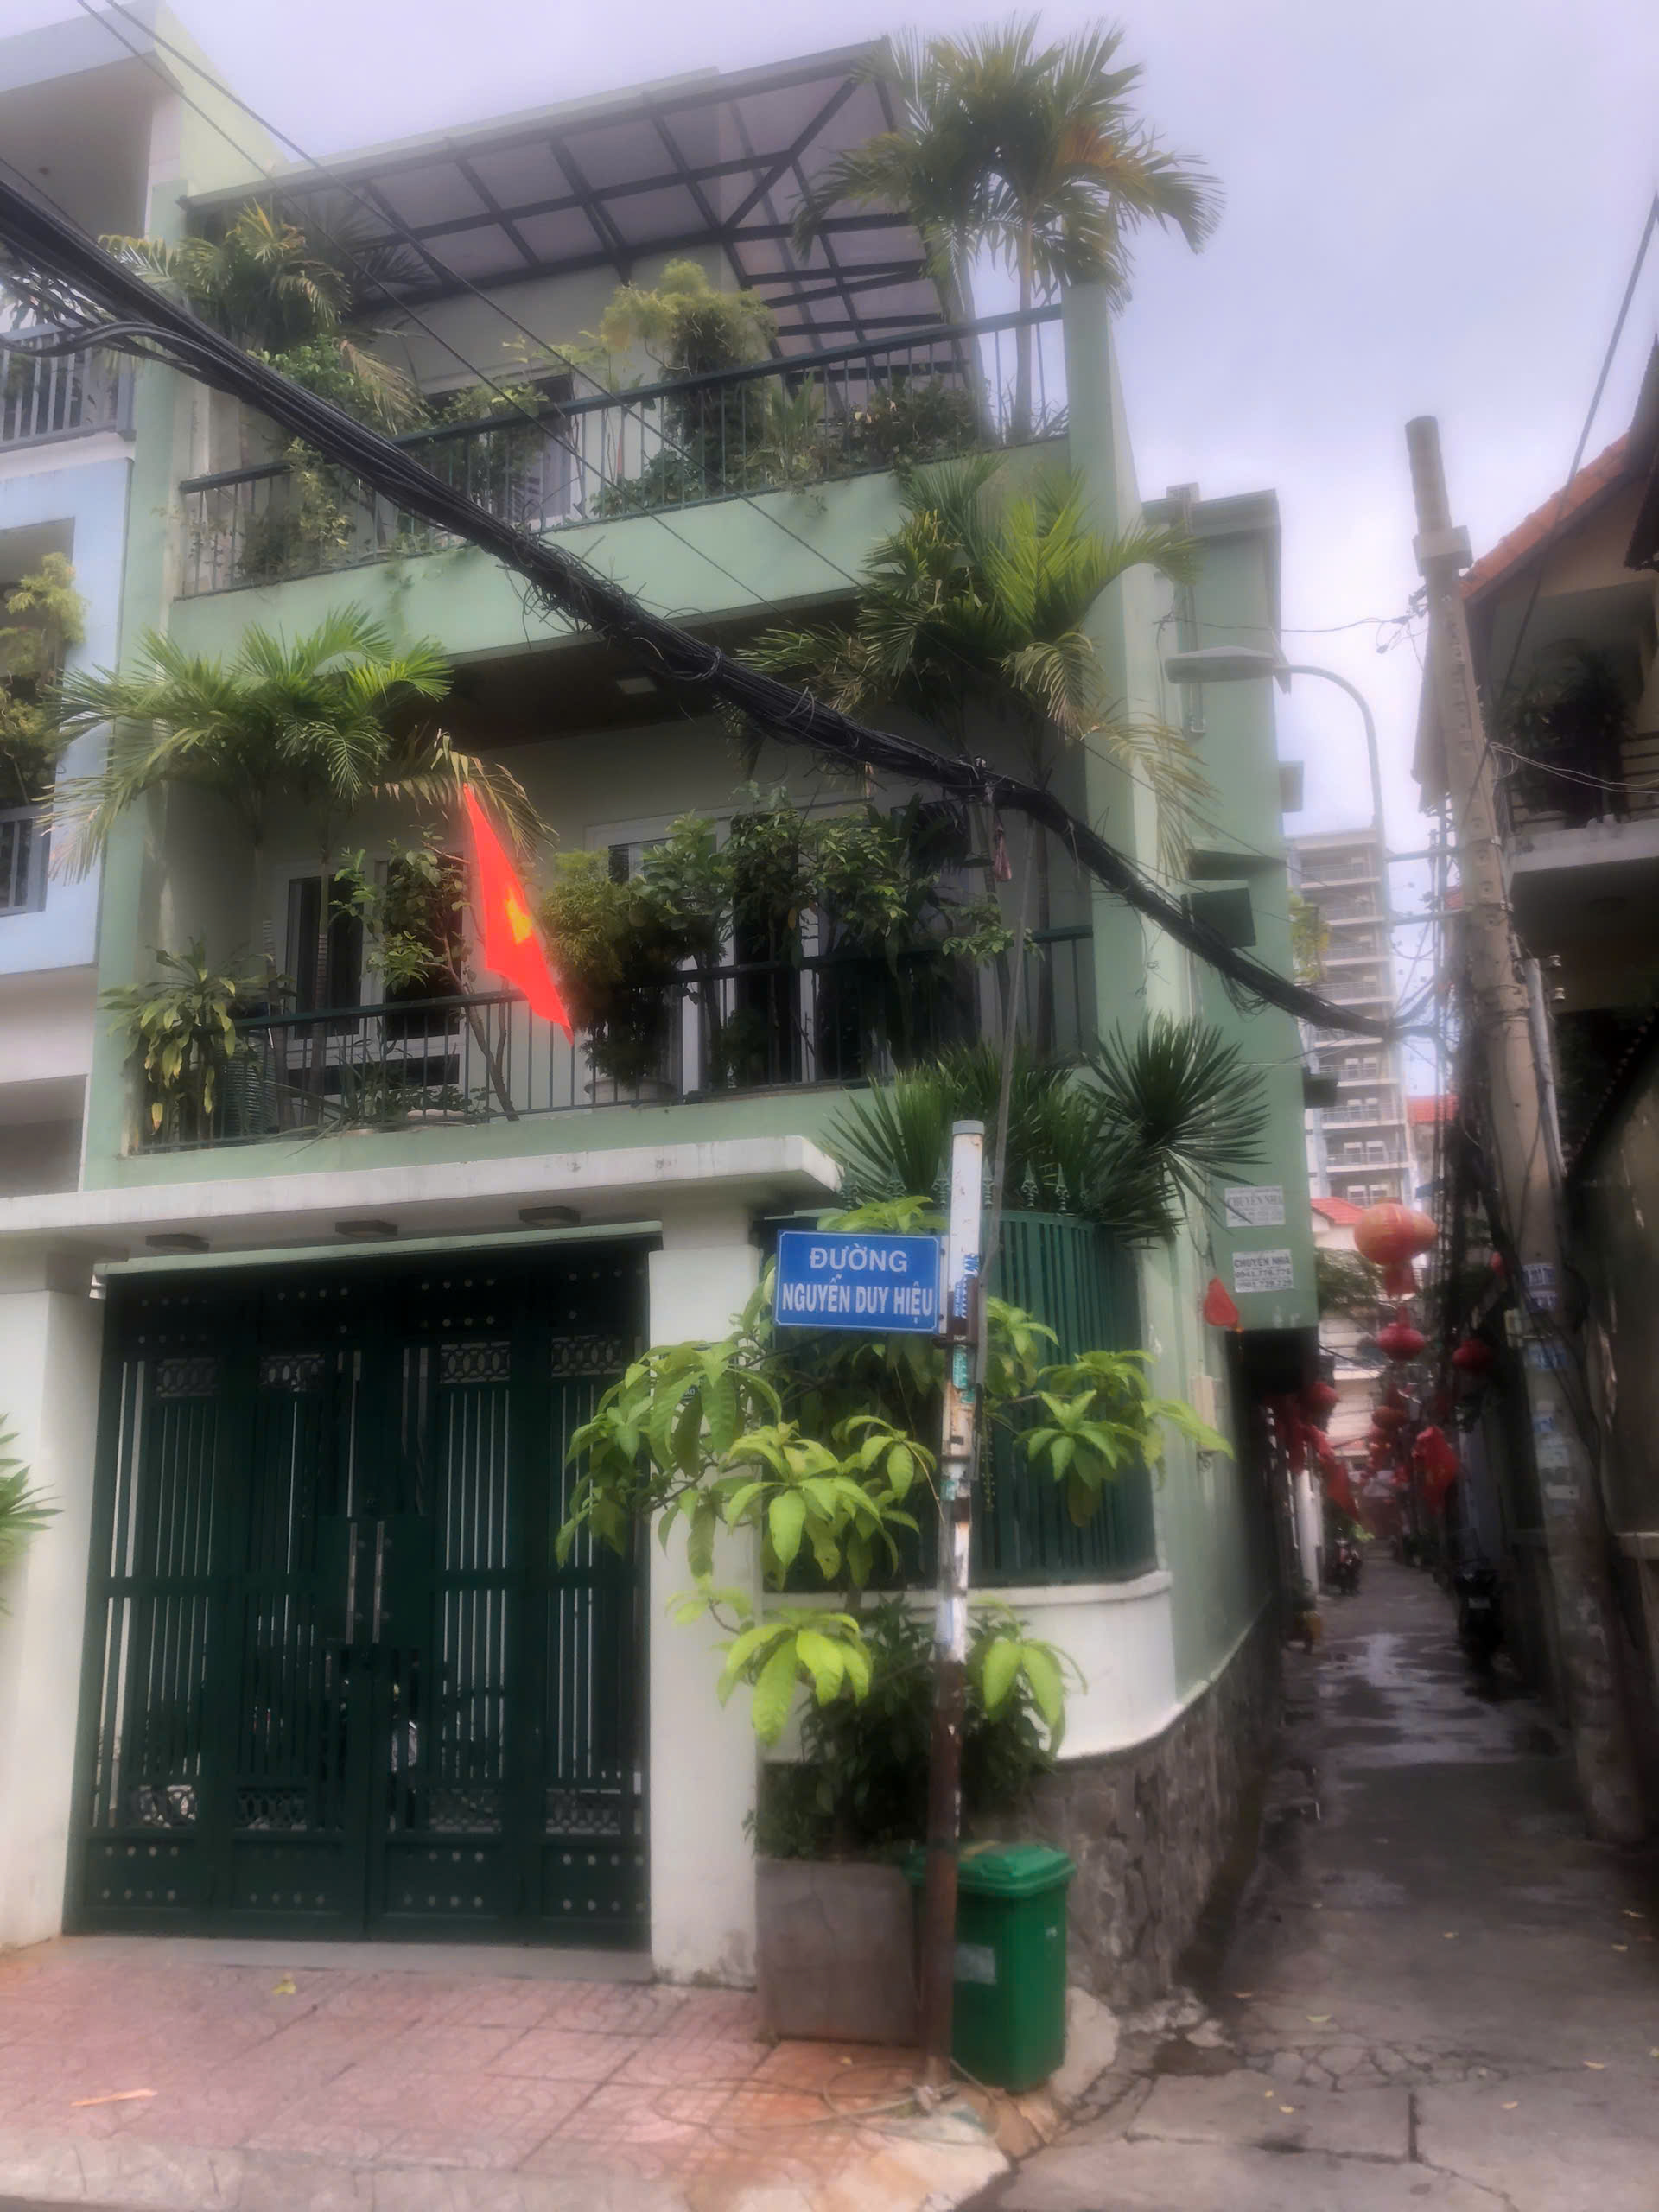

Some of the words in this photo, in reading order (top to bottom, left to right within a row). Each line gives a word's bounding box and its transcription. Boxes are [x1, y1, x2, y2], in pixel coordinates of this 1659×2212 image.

[810, 1243, 907, 1273] ĐƯỜNG
[782, 1274, 850, 1313] NGUYỄN
[855, 1284, 889, 1314] DUY
[893, 1281, 933, 1325] HIỆU
